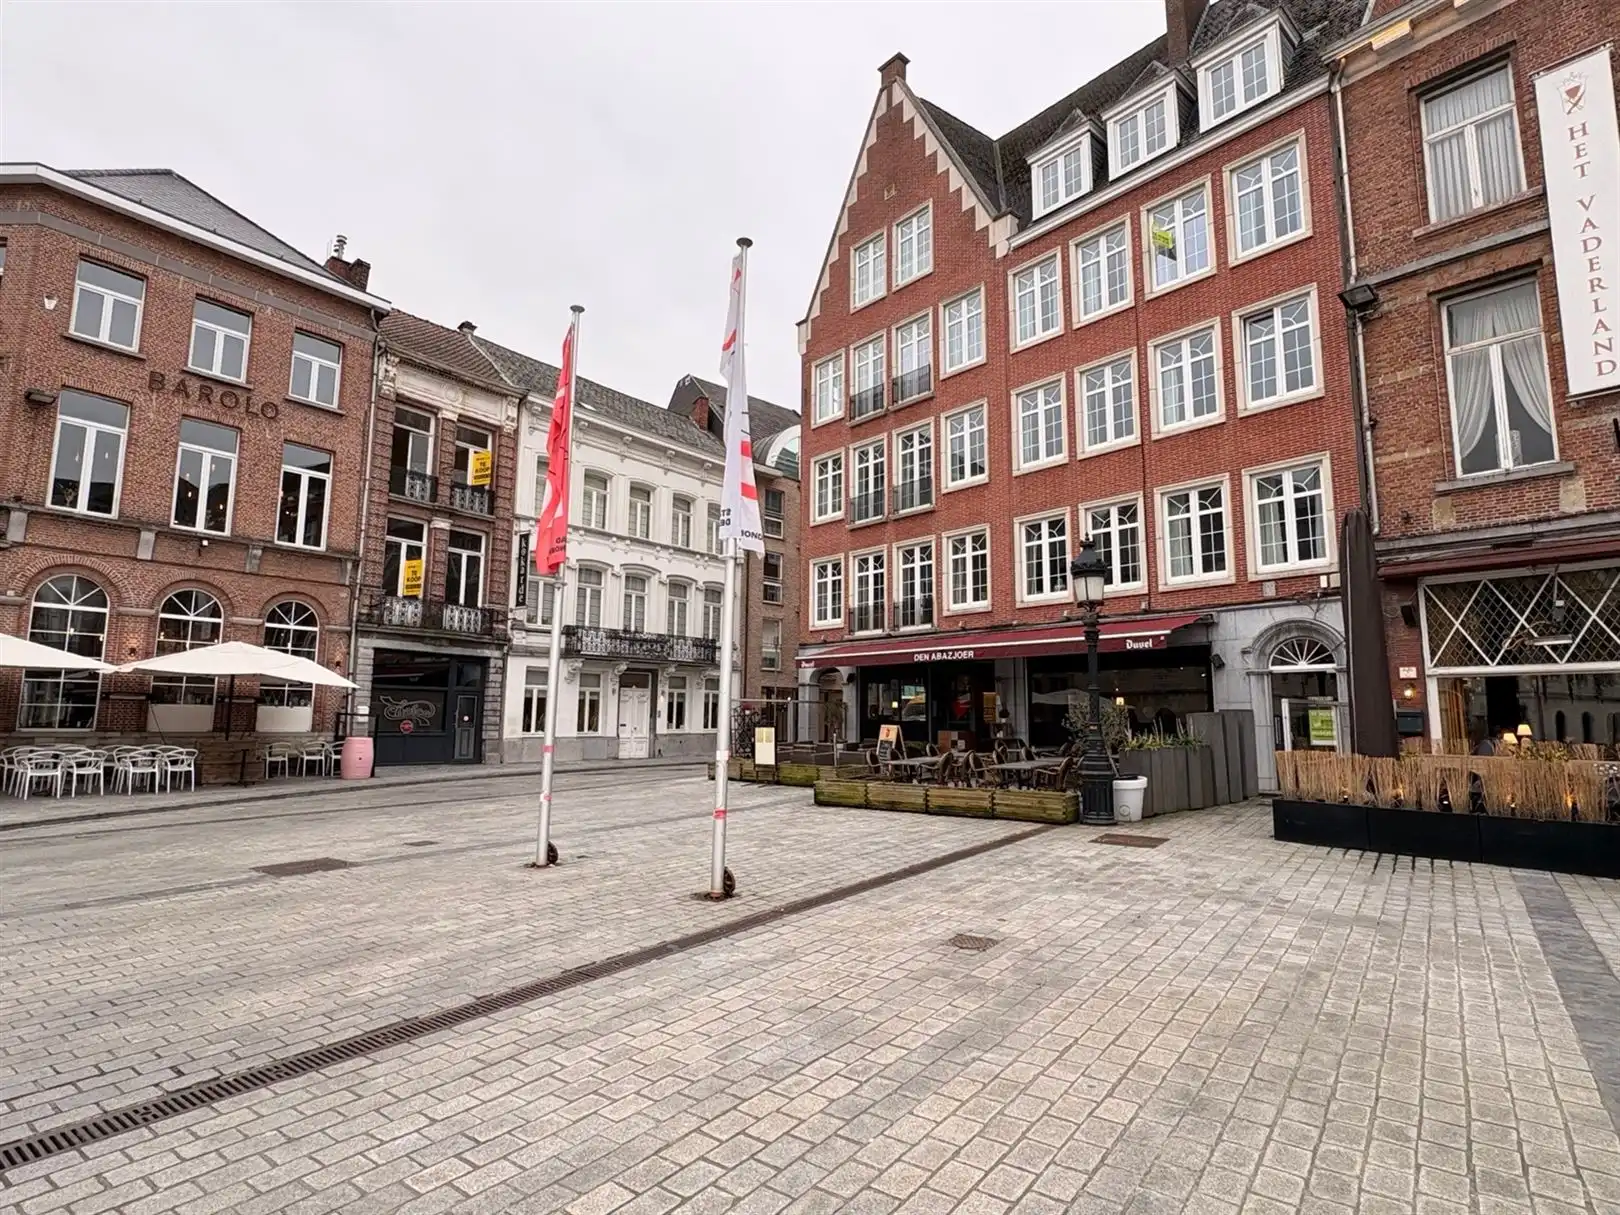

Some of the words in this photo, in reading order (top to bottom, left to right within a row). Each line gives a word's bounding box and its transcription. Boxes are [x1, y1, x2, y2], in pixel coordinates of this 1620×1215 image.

[1568, 121, 1591, 179] HET
[1577, 195, 1617, 377] VADERLAND
[149, 371, 279, 420] BAROLO
[913, 653, 930, 662] DEN
[931, 650, 975, 661] ABAZJOER
[1126, 638, 1153, 650] Duvel
